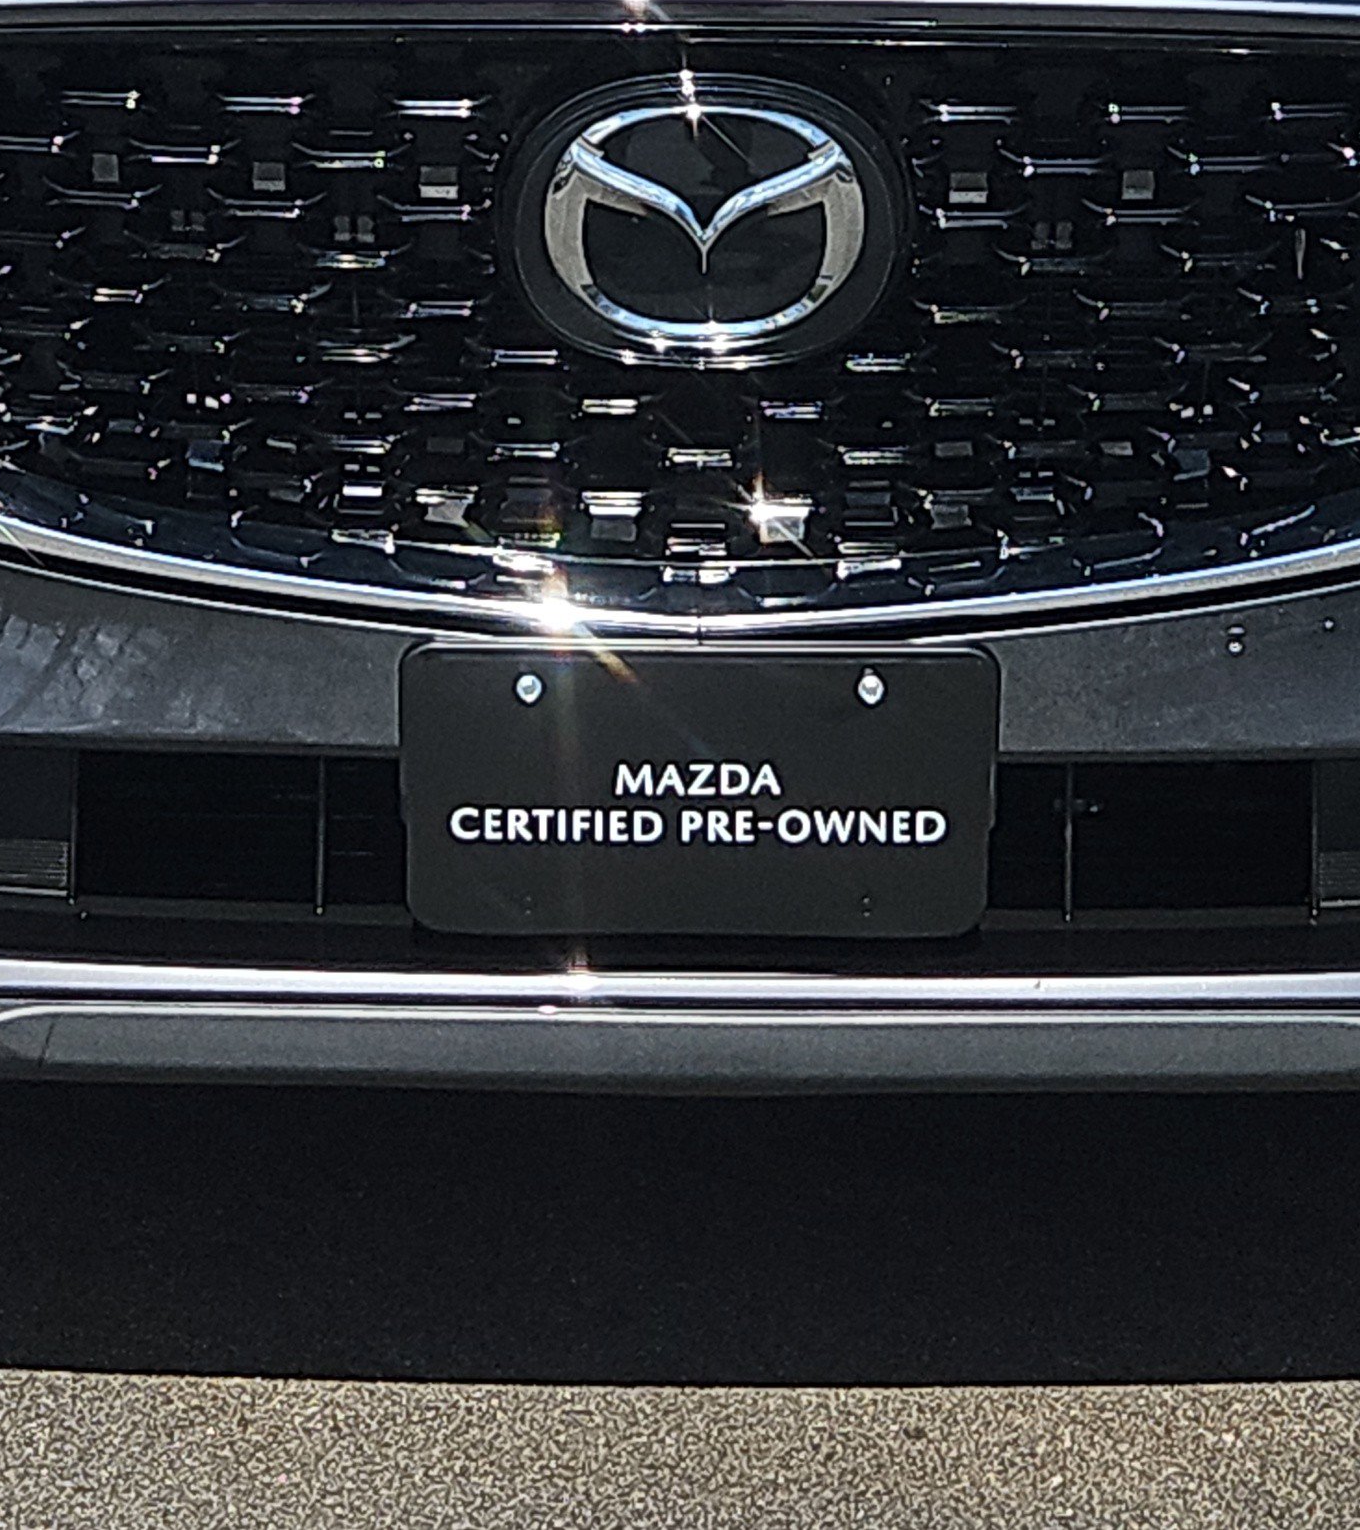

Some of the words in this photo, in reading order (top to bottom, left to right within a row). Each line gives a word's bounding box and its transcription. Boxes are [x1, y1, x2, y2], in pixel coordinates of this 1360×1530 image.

[615, 763, 782, 797] MAZDA
[449, 806, 664, 843] CERTIFIED
[681, 808, 947, 844] PRE-OWNED
